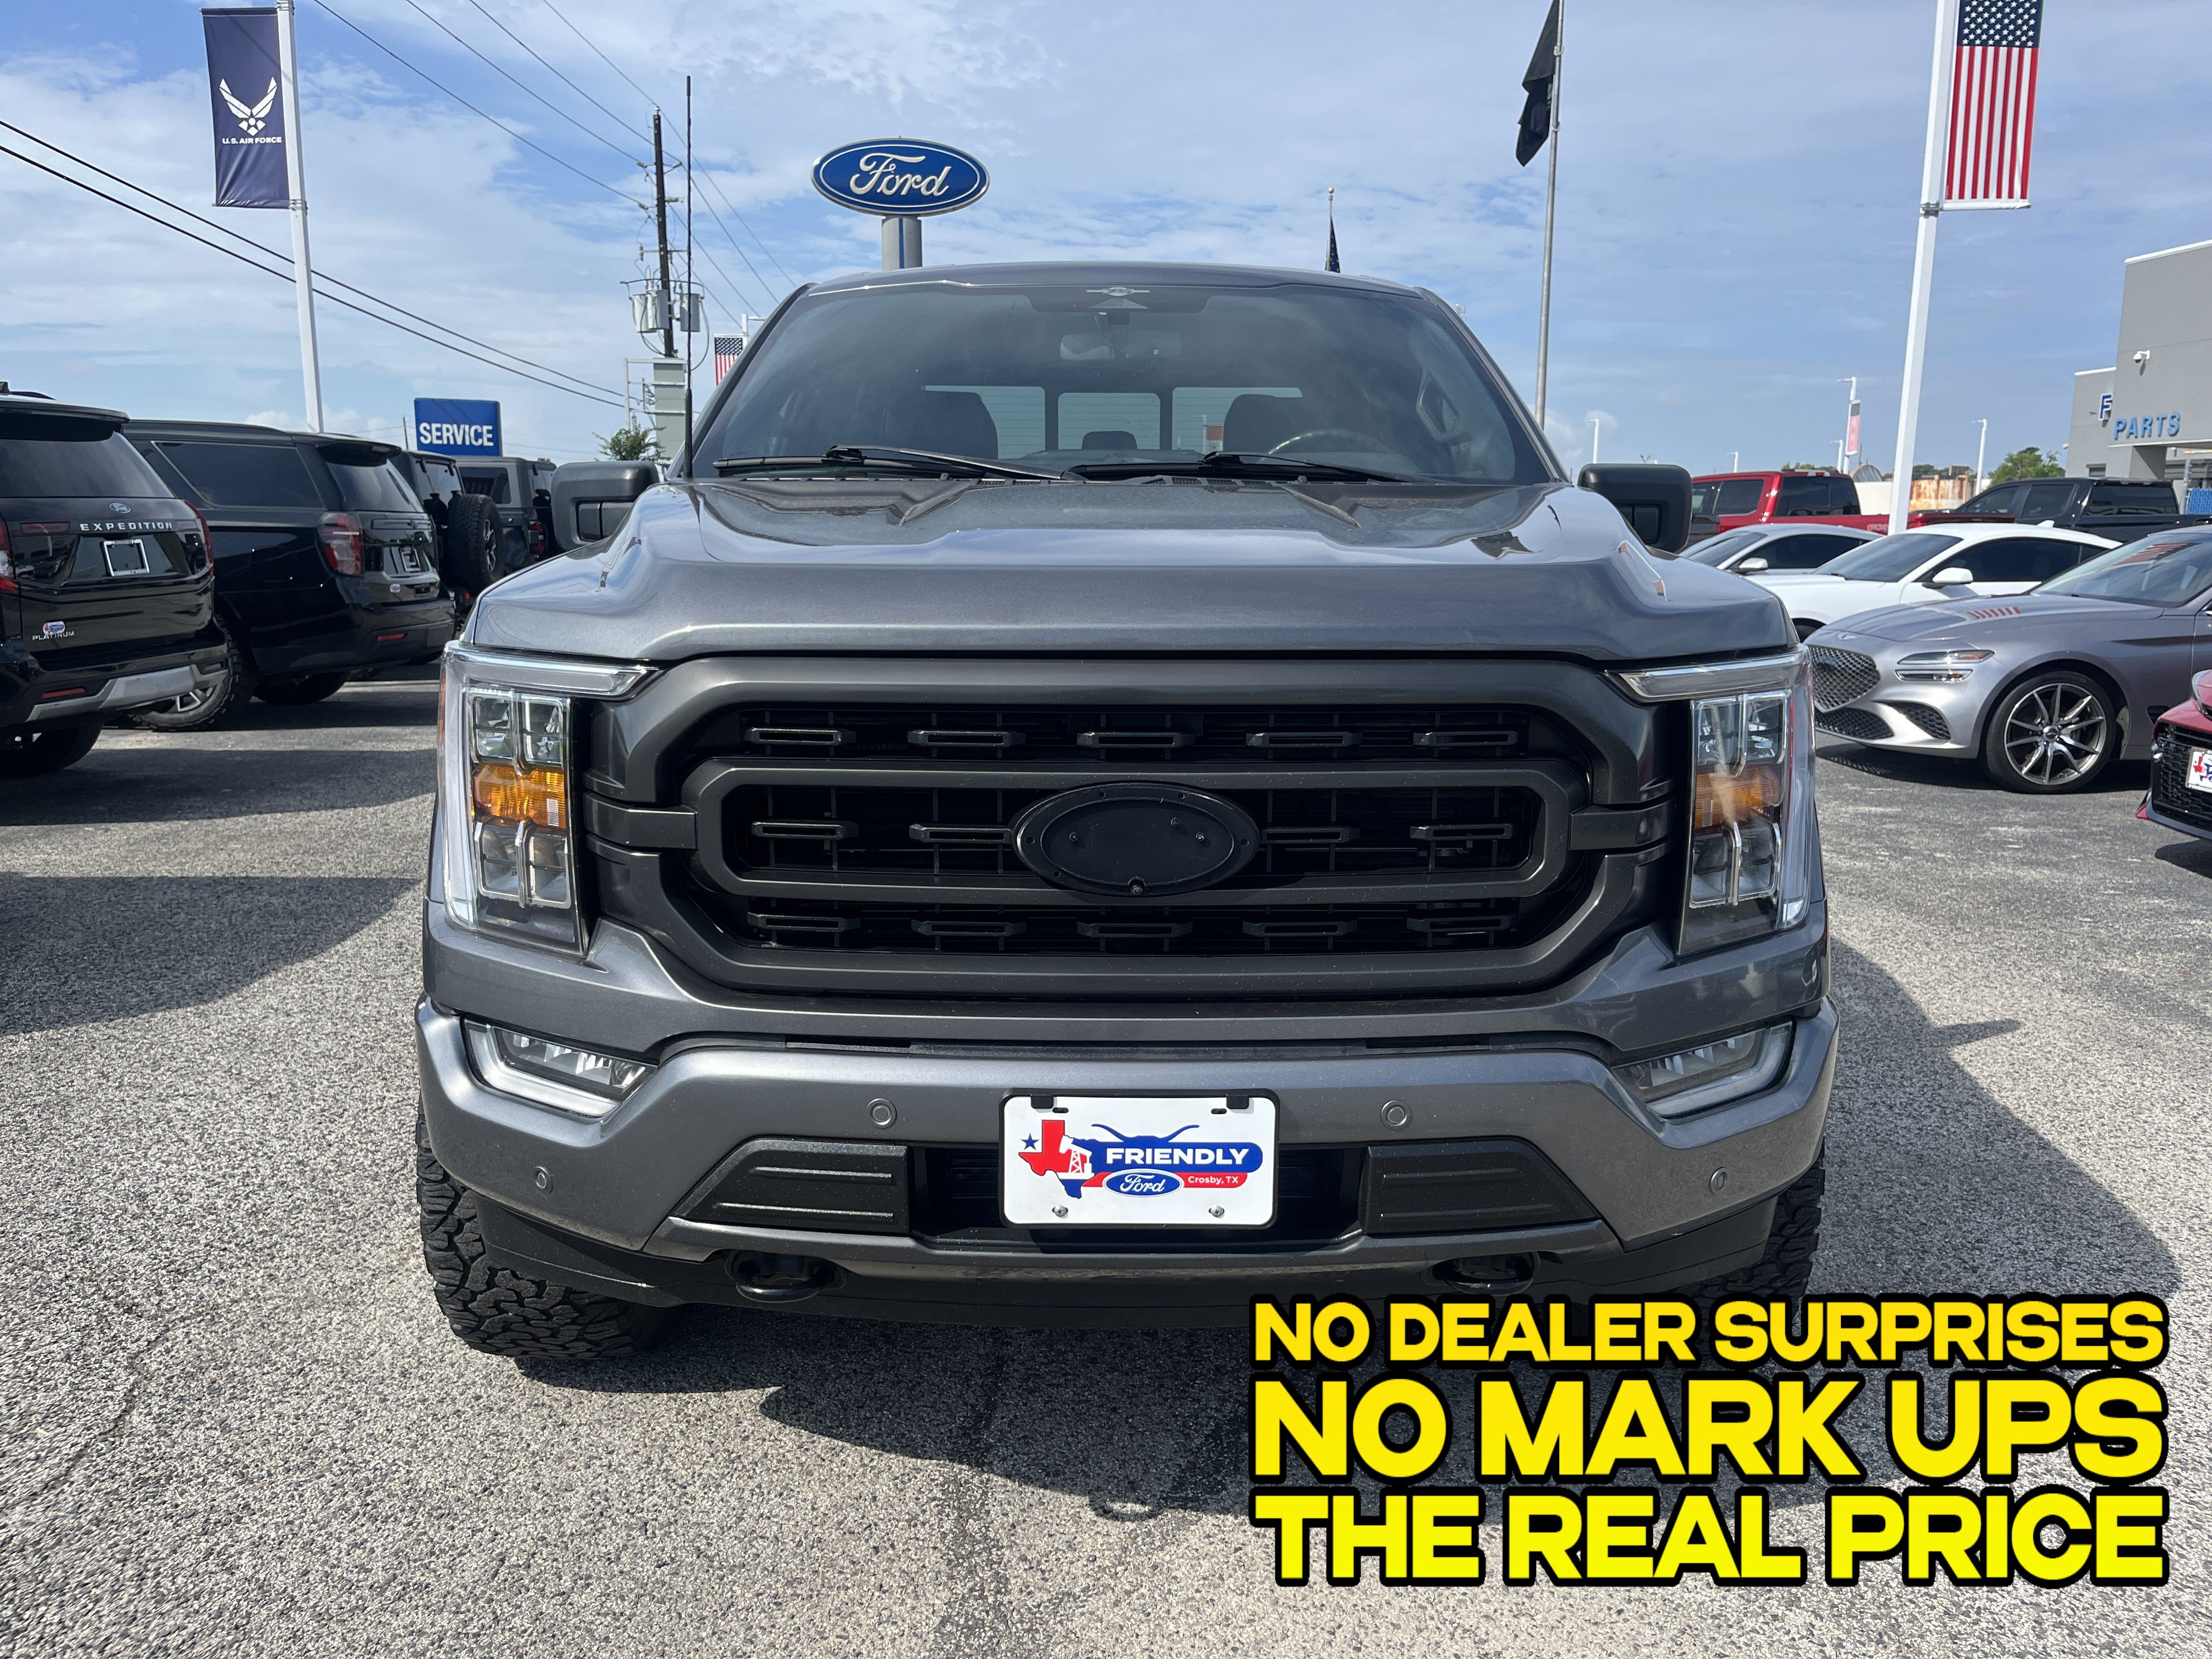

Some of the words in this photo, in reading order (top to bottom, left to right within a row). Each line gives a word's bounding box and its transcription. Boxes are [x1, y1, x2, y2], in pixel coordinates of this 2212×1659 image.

[849, 153, 952, 197] Ford
[419, 421, 494, 447] SERVICE
[2114, 411, 2181, 441] PARTS
[80, 522, 173, 532] EXPEDITION
[32, 631, 75, 641] PLATINUM
[1106, 1148, 1250, 1165] FRIENDLY
[1119, 1173, 1166, 1193] Ford
[1187, 1175, 1224, 1185] Crosby,
[1226, 1176, 1239, 1184] TX
